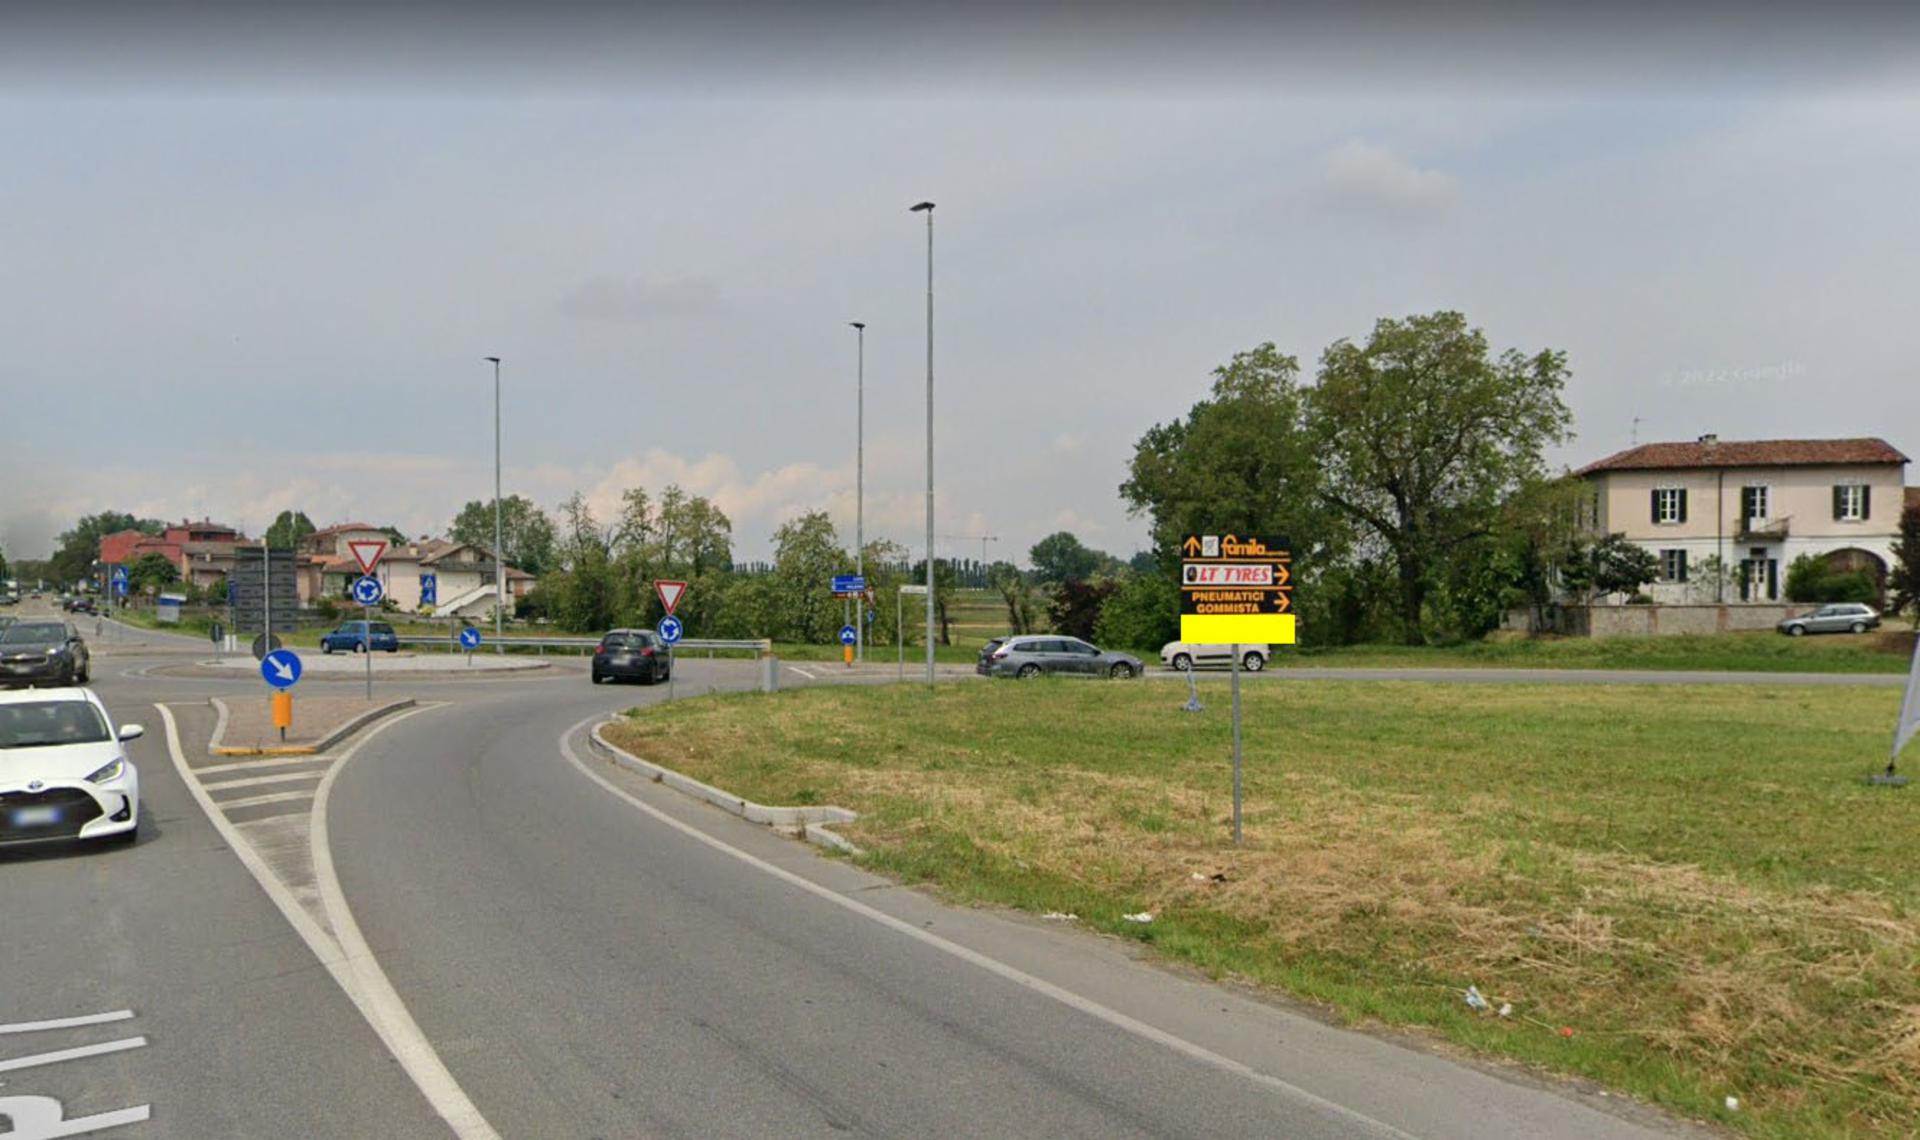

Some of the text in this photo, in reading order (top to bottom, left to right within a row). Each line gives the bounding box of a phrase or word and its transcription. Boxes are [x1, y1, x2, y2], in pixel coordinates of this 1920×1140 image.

[1200, 567, 1270, 581] LT TYRES
[1192, 592, 1264, 601] PNEUMATICI
[1196, 603, 1260, 613] GOMMISTA
